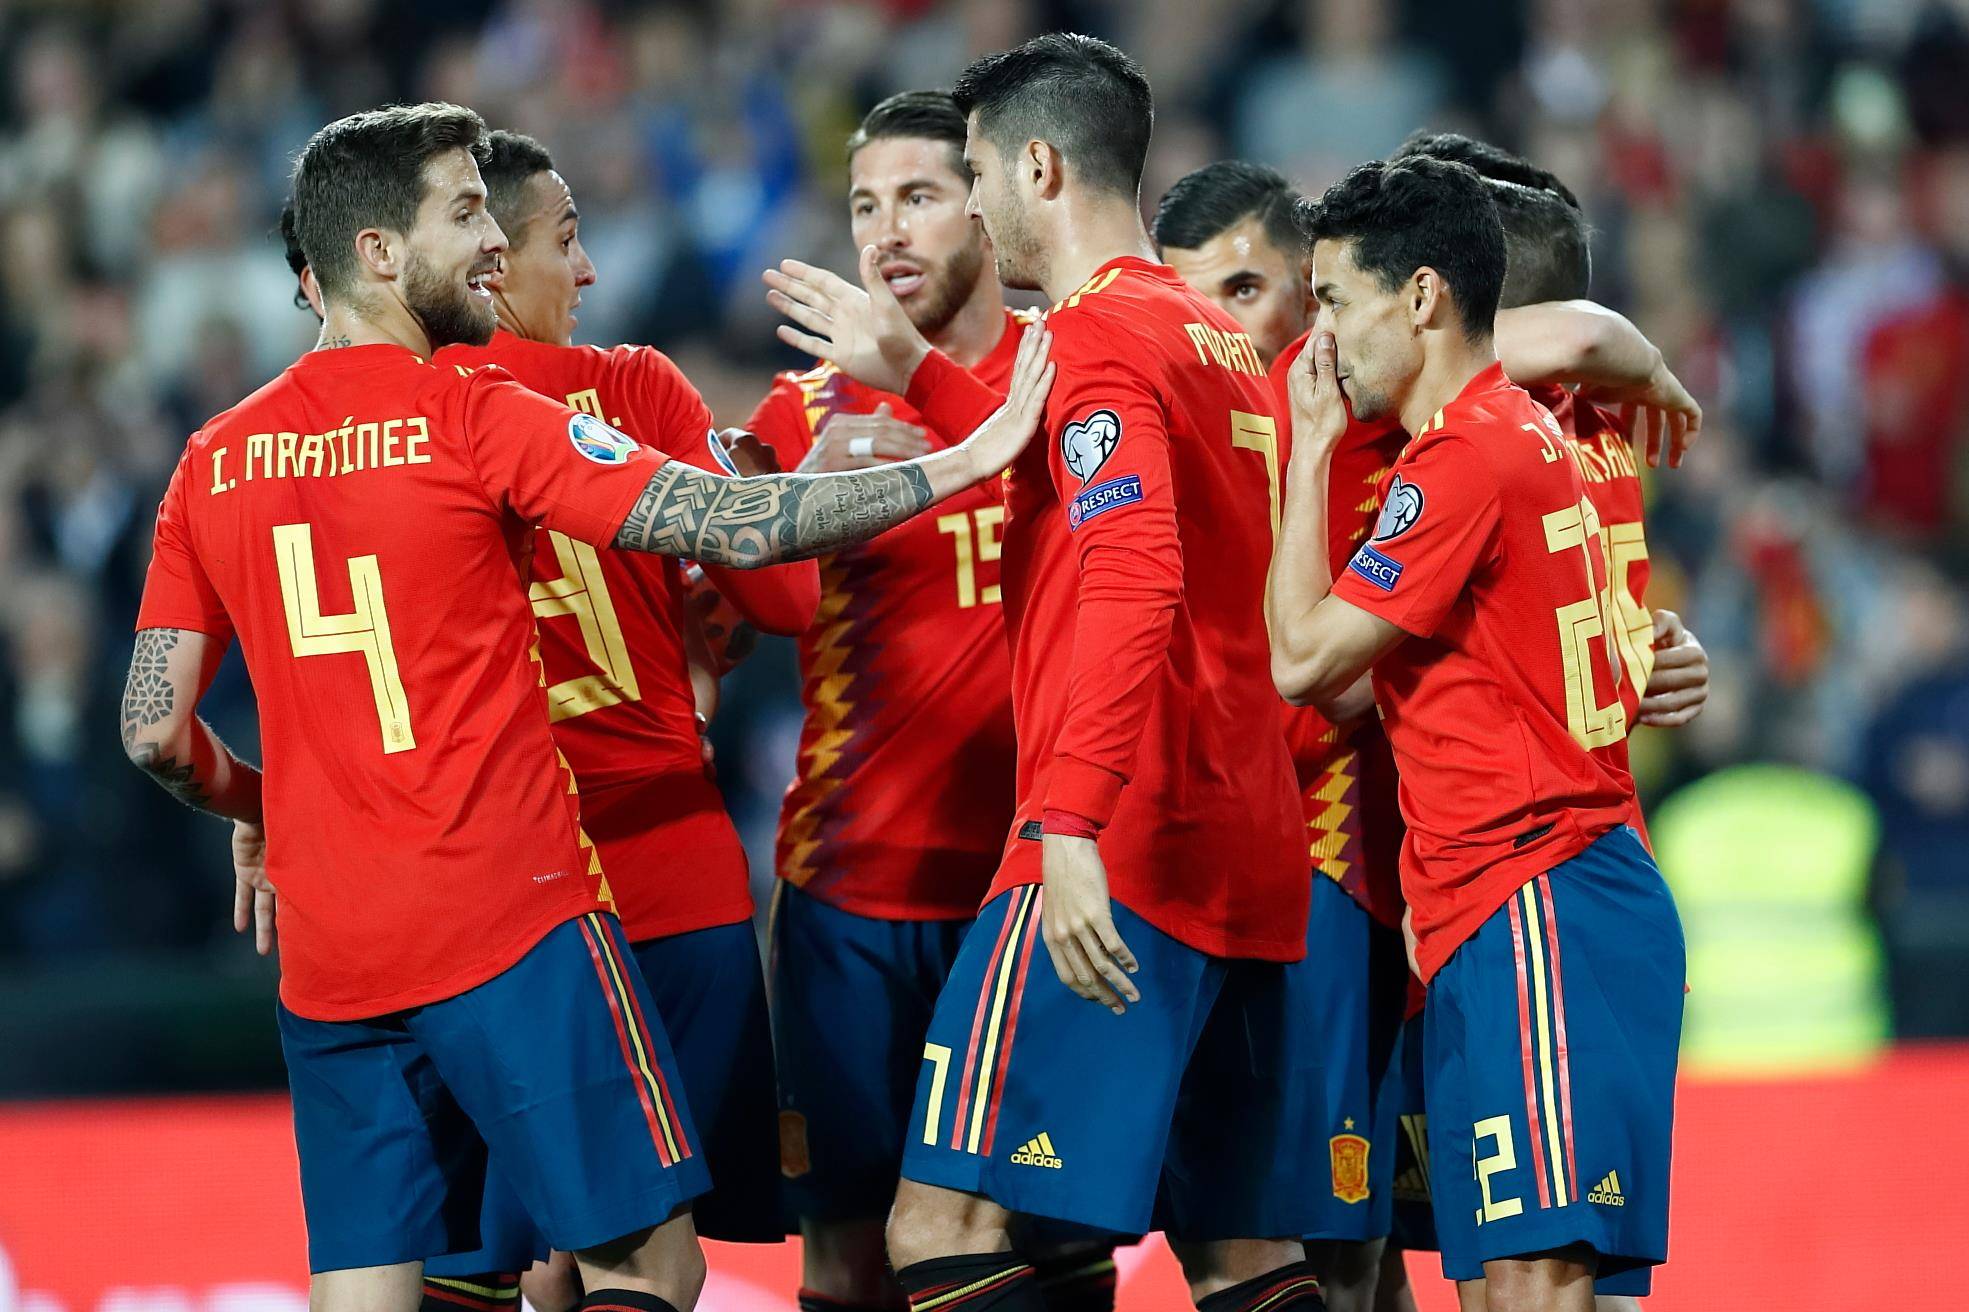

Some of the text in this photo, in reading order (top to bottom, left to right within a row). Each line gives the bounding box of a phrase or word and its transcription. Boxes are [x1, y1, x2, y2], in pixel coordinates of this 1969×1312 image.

[210, 446, 236, 496] I.
[1081, 482, 1140, 514] RESPECT
[936, 505, 1005, 608] 15
[272, 522, 417, 755] 4
[1010, 1151, 1063, 1169] adidas
[1472, 1114, 1524, 1227] 2
[1587, 1190, 1625, 1207] adidas
